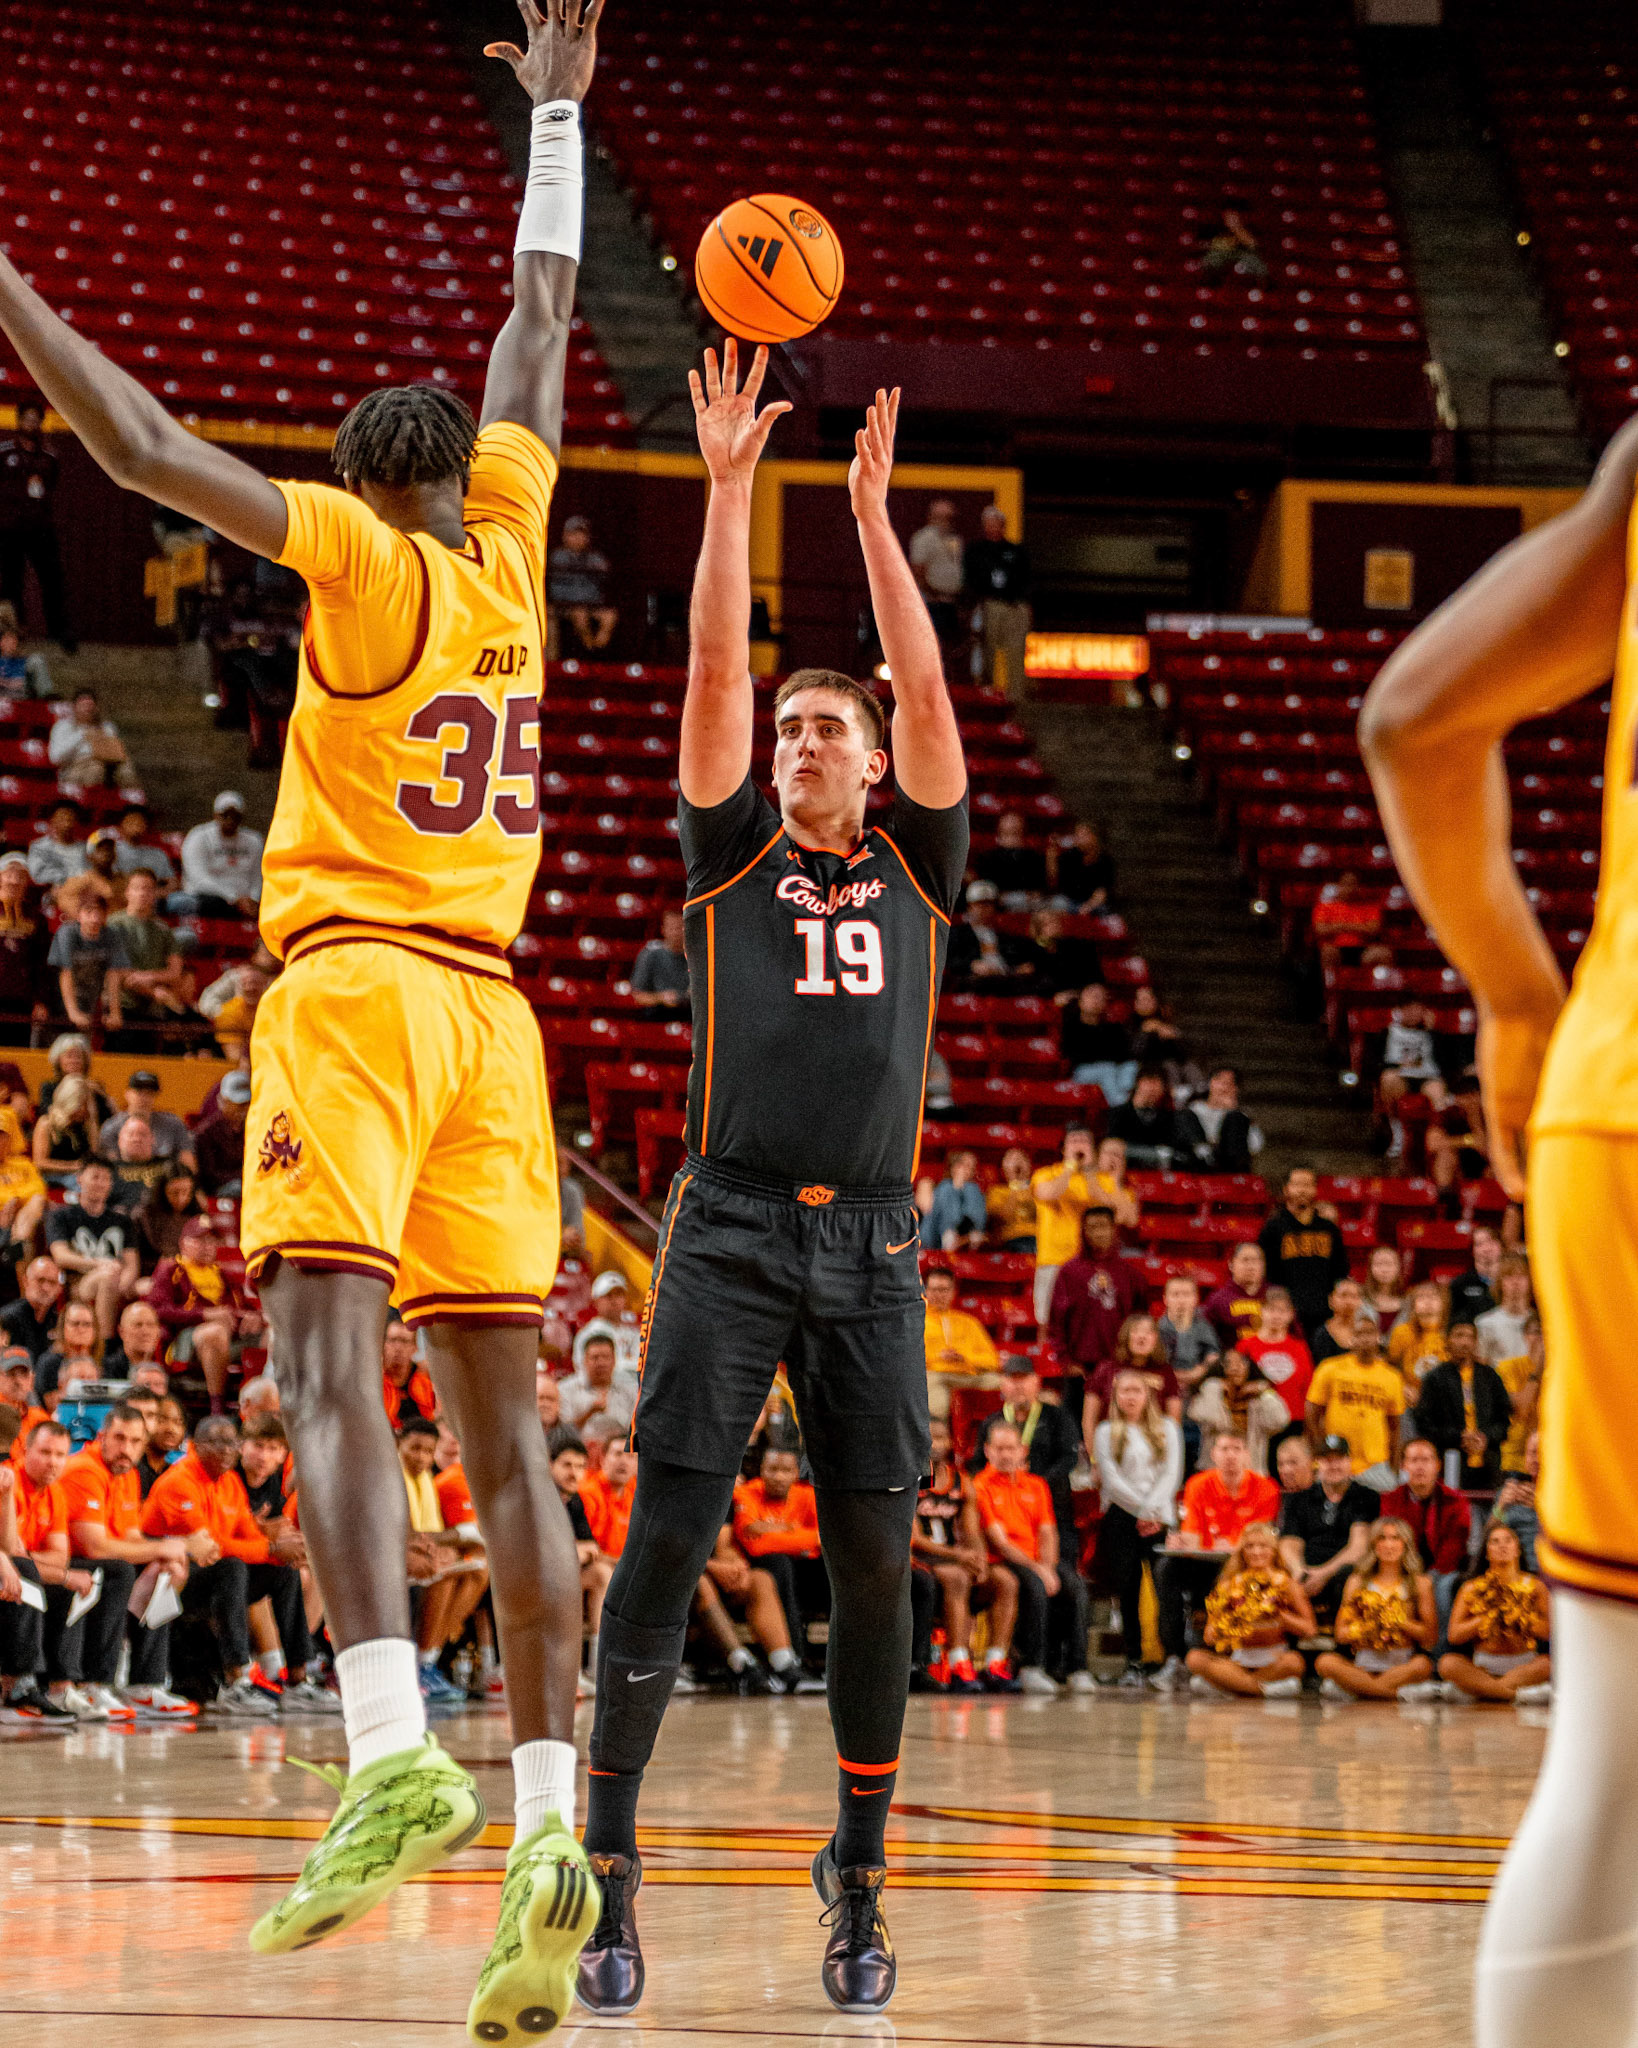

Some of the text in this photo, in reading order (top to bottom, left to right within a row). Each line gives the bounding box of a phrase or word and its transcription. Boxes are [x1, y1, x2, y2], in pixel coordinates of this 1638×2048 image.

[395, 692, 541, 838] 35
[776, 874, 888, 916] Cowboys
[794, 918, 885, 996] 19
